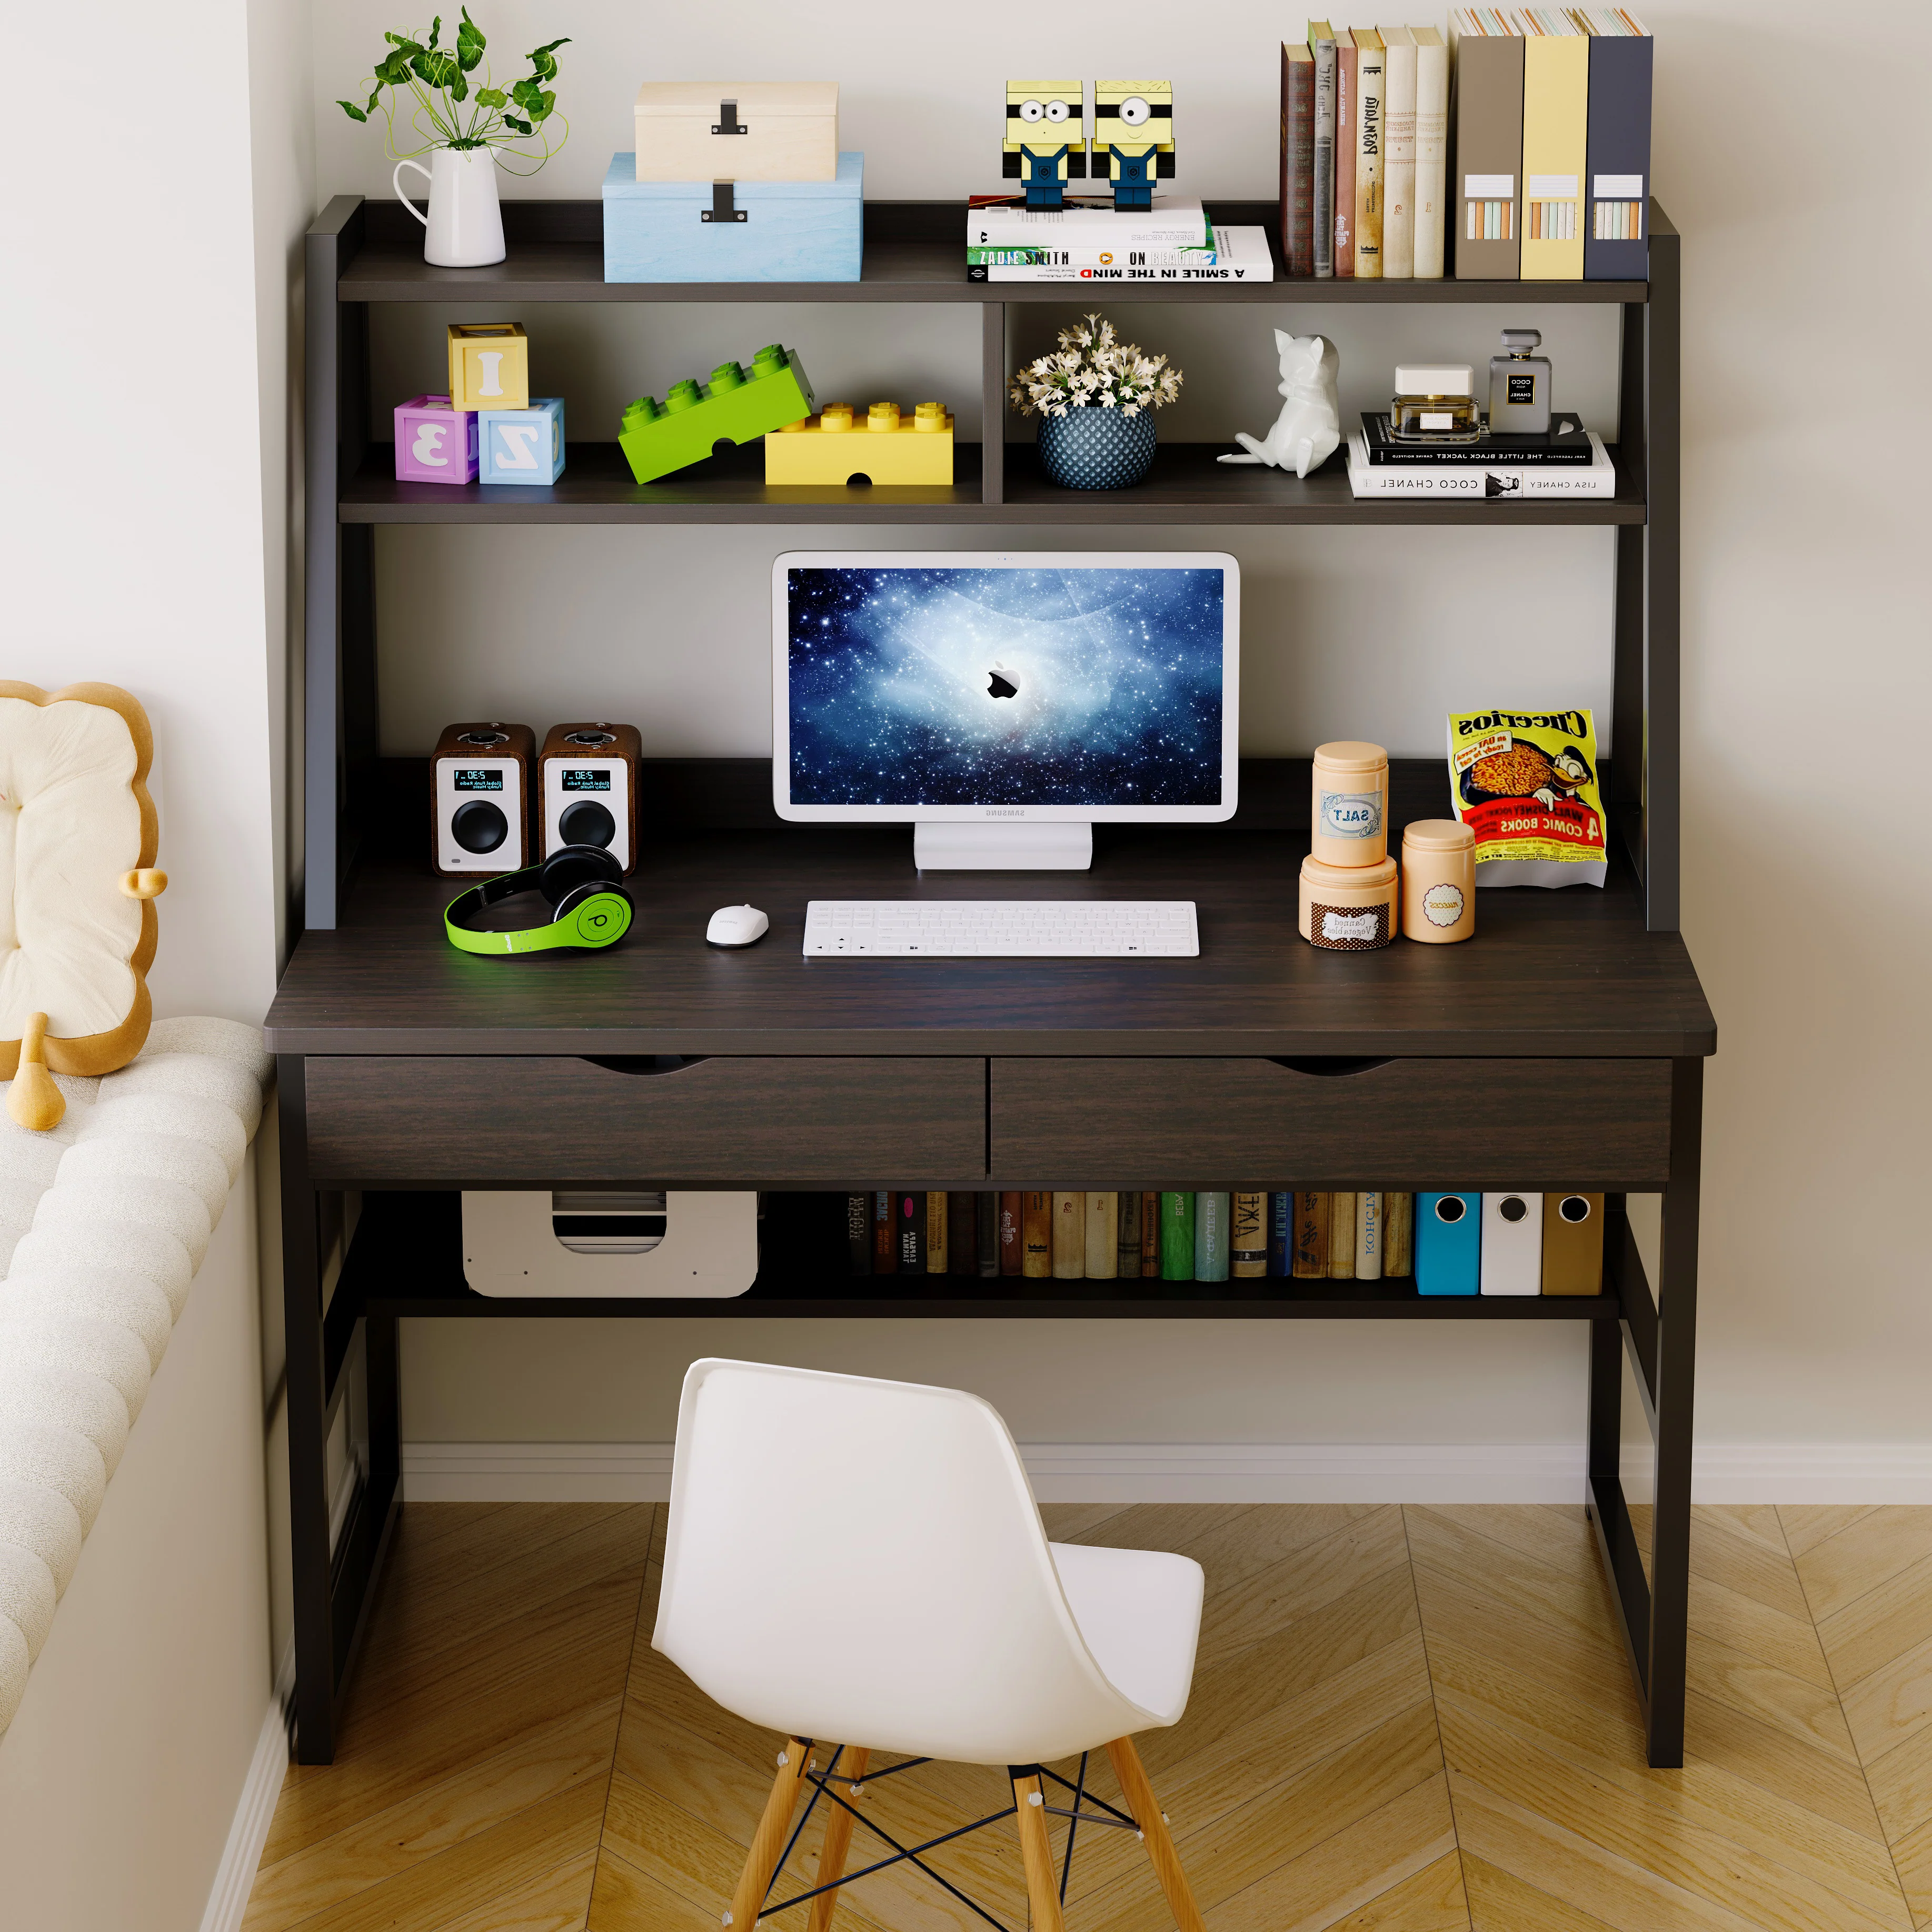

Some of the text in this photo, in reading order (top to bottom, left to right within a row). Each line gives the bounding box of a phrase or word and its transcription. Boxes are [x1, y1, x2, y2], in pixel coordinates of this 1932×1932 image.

[980, 252, 1204, 265] ZADIE SMITH ON BEAUTY
[1080, 269, 1245, 278] A SMILE IN THE MIND
